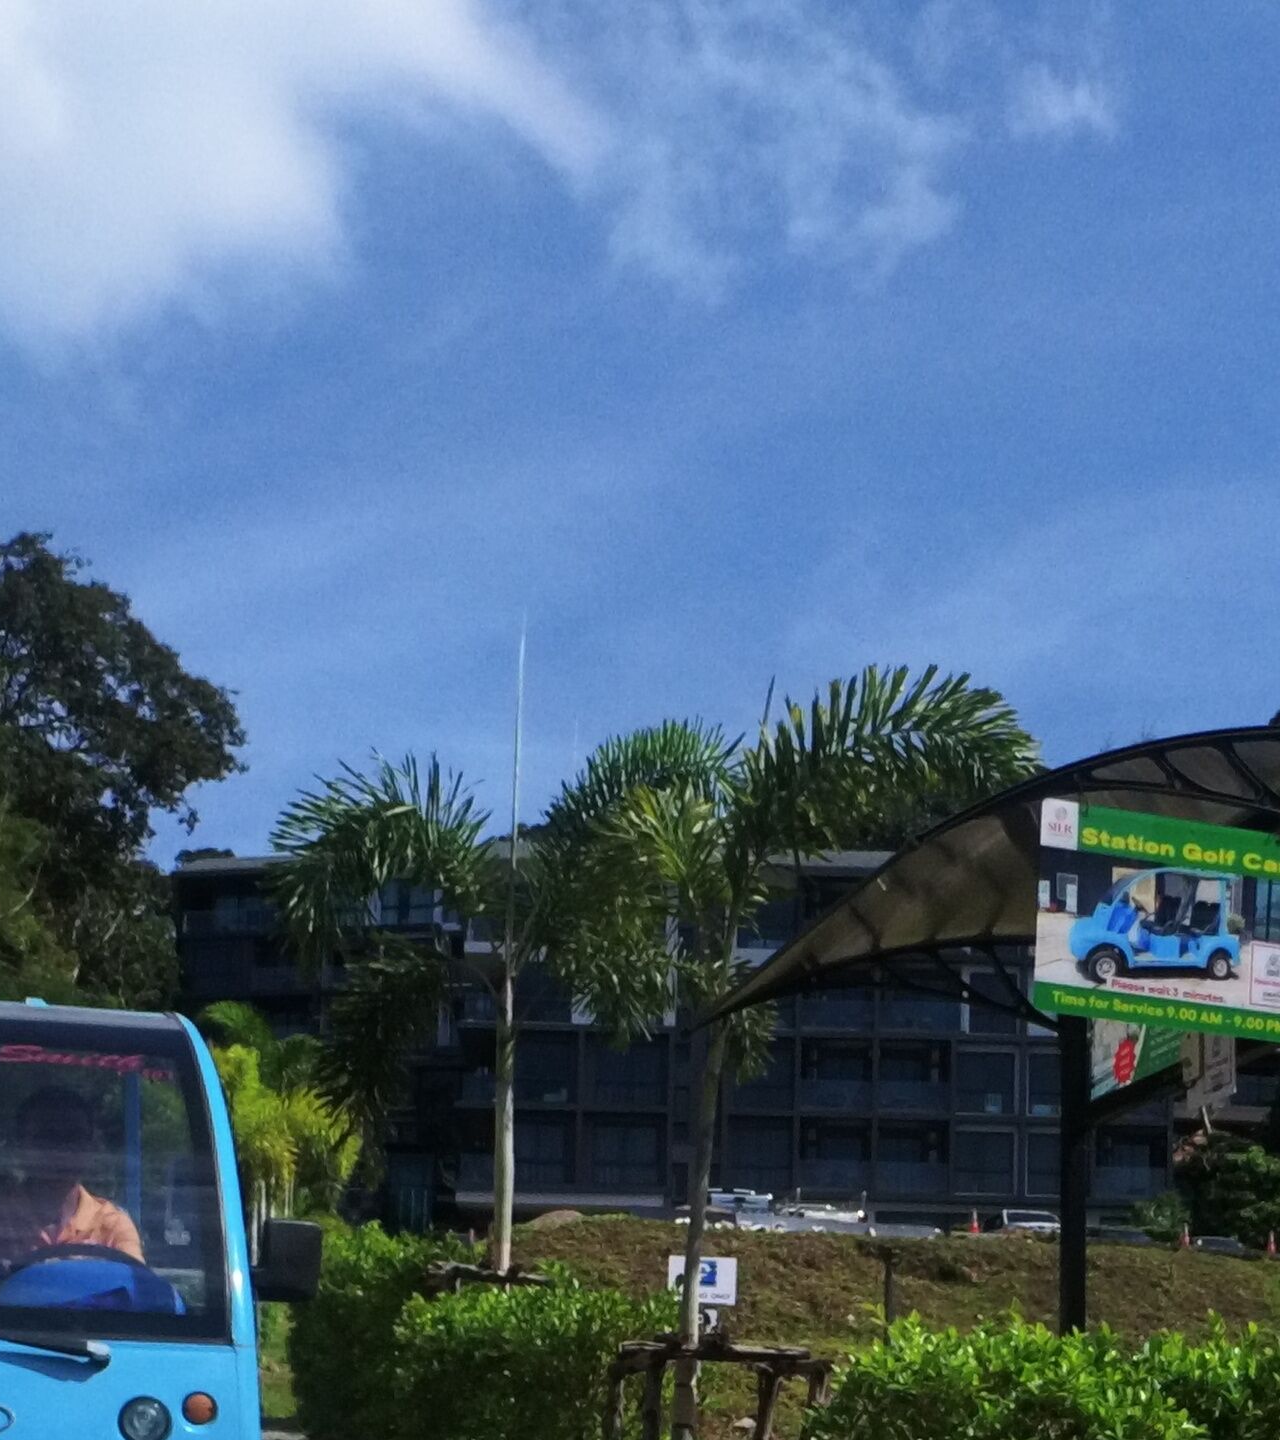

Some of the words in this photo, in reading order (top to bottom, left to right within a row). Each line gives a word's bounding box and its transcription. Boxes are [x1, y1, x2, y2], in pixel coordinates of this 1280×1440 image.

[1081, 826, 1176, 858] Station
[1182, 842, 1236, 866] Golf
[1051, 990, 1086, 1008] Time
[1088, 993, 1109, 1009] for
[1112, 999, 1164, 1017] Service
[1166, 1005, 1197, 1021] 9.00
[1199, 1011, 1223, 1025] AM
[1148, 985, 1171, 996] wait
